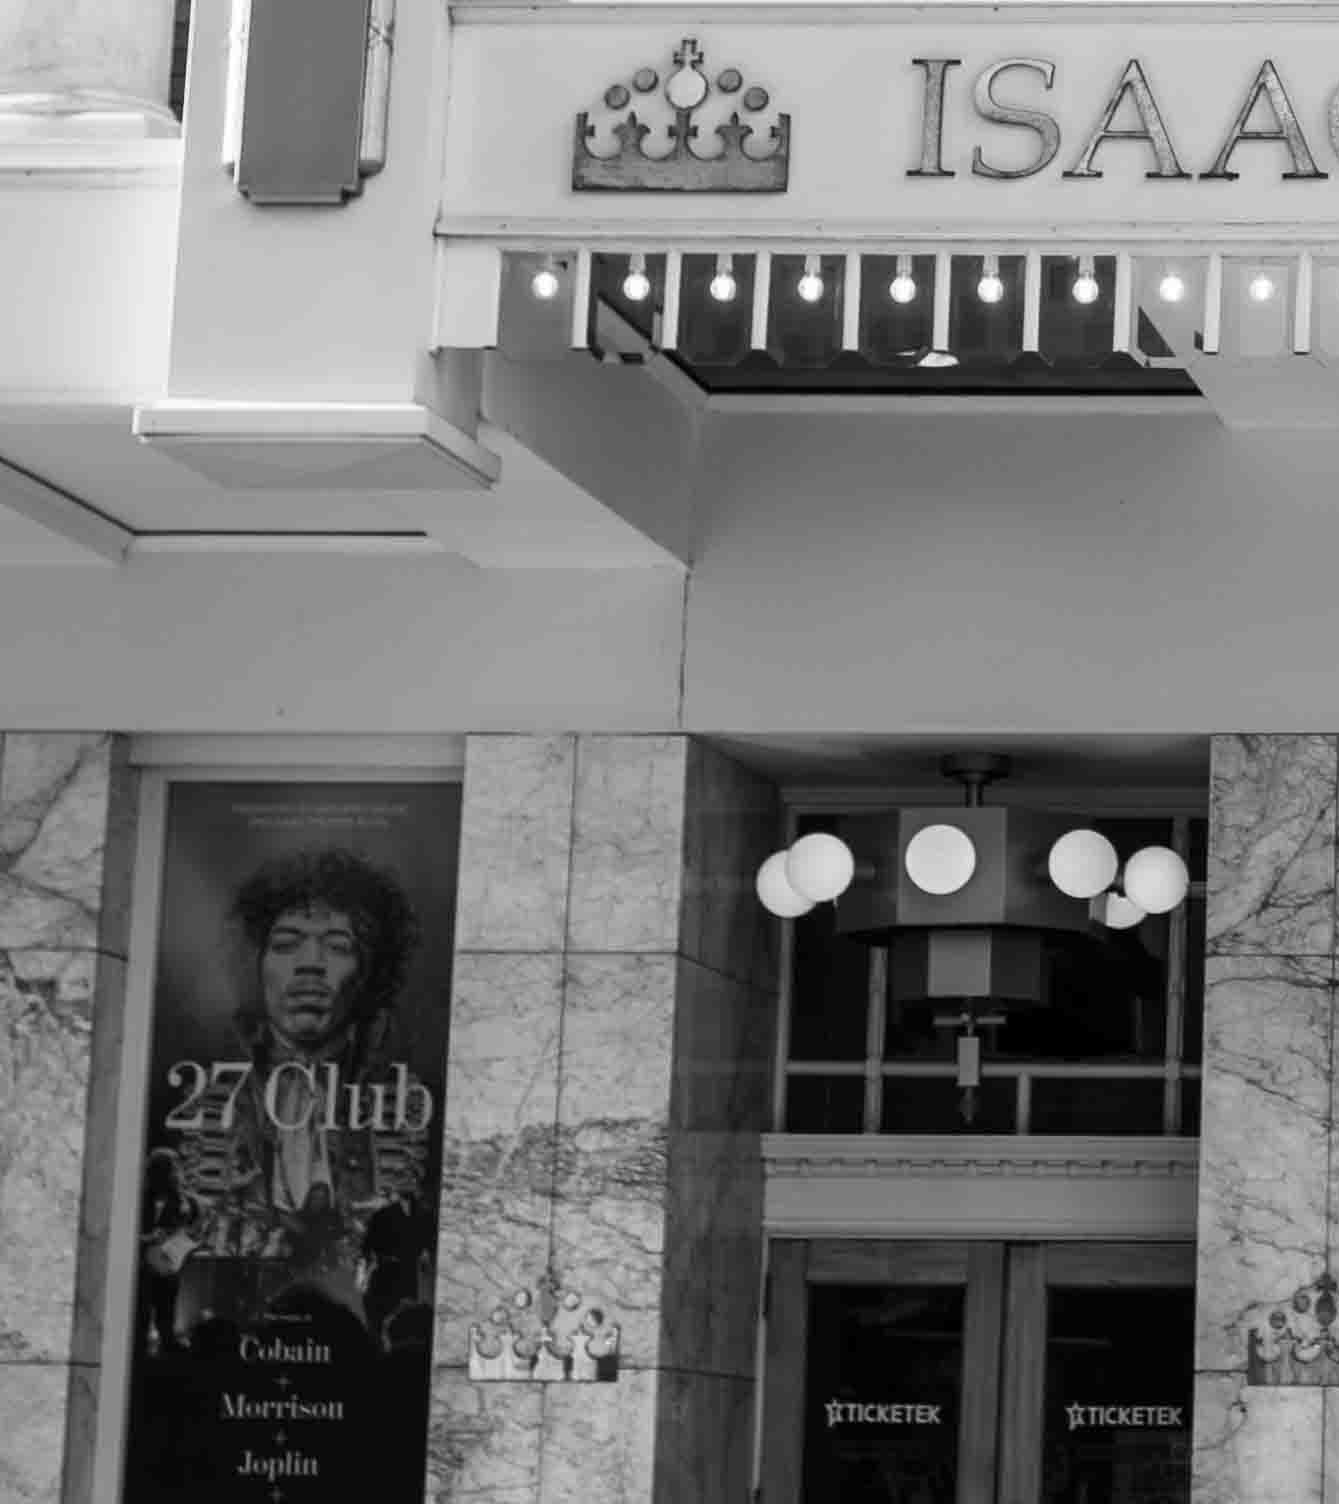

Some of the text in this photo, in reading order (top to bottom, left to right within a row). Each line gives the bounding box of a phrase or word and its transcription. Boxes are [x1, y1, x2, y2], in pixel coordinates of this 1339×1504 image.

[165, 1060, 433, 1132] 27 Club
[239, 1335, 333, 1363] Cobain
[222, 1393, 345, 1421] Morrison
[848, 1403, 942, 1425] TICKETEK
[1088, 1406, 1183, 1428] TICKETEK
[236, 1450, 320, 1483] Joplin
